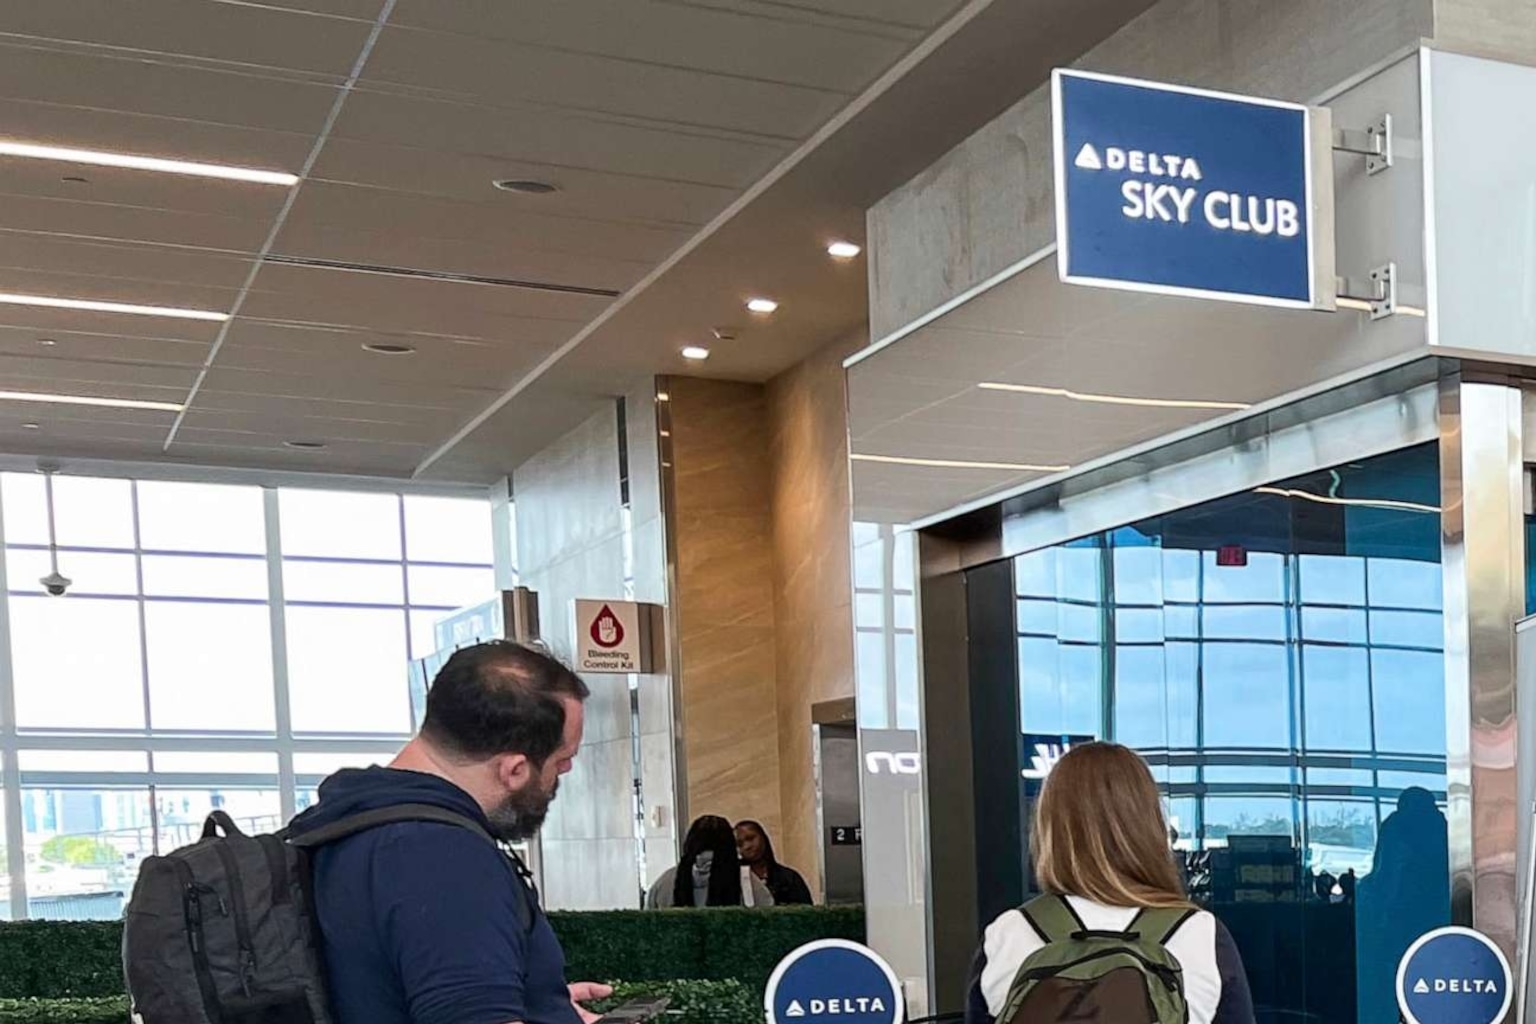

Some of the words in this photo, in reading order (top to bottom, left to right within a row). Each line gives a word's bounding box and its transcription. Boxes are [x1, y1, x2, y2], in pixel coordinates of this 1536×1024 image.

[1106, 147, 1202, 180] DELTA
[1121, 180, 1197, 223] SKY
[1204, 190, 1299, 237] CLUB
[588, 649, 630, 660] Bleeding
[583, 660, 619, 669] Control
[621, 660, 634, 669] Kit
[1434, 979, 1497, 994] DELTA
[810, 997, 885, 1015] DELTA
